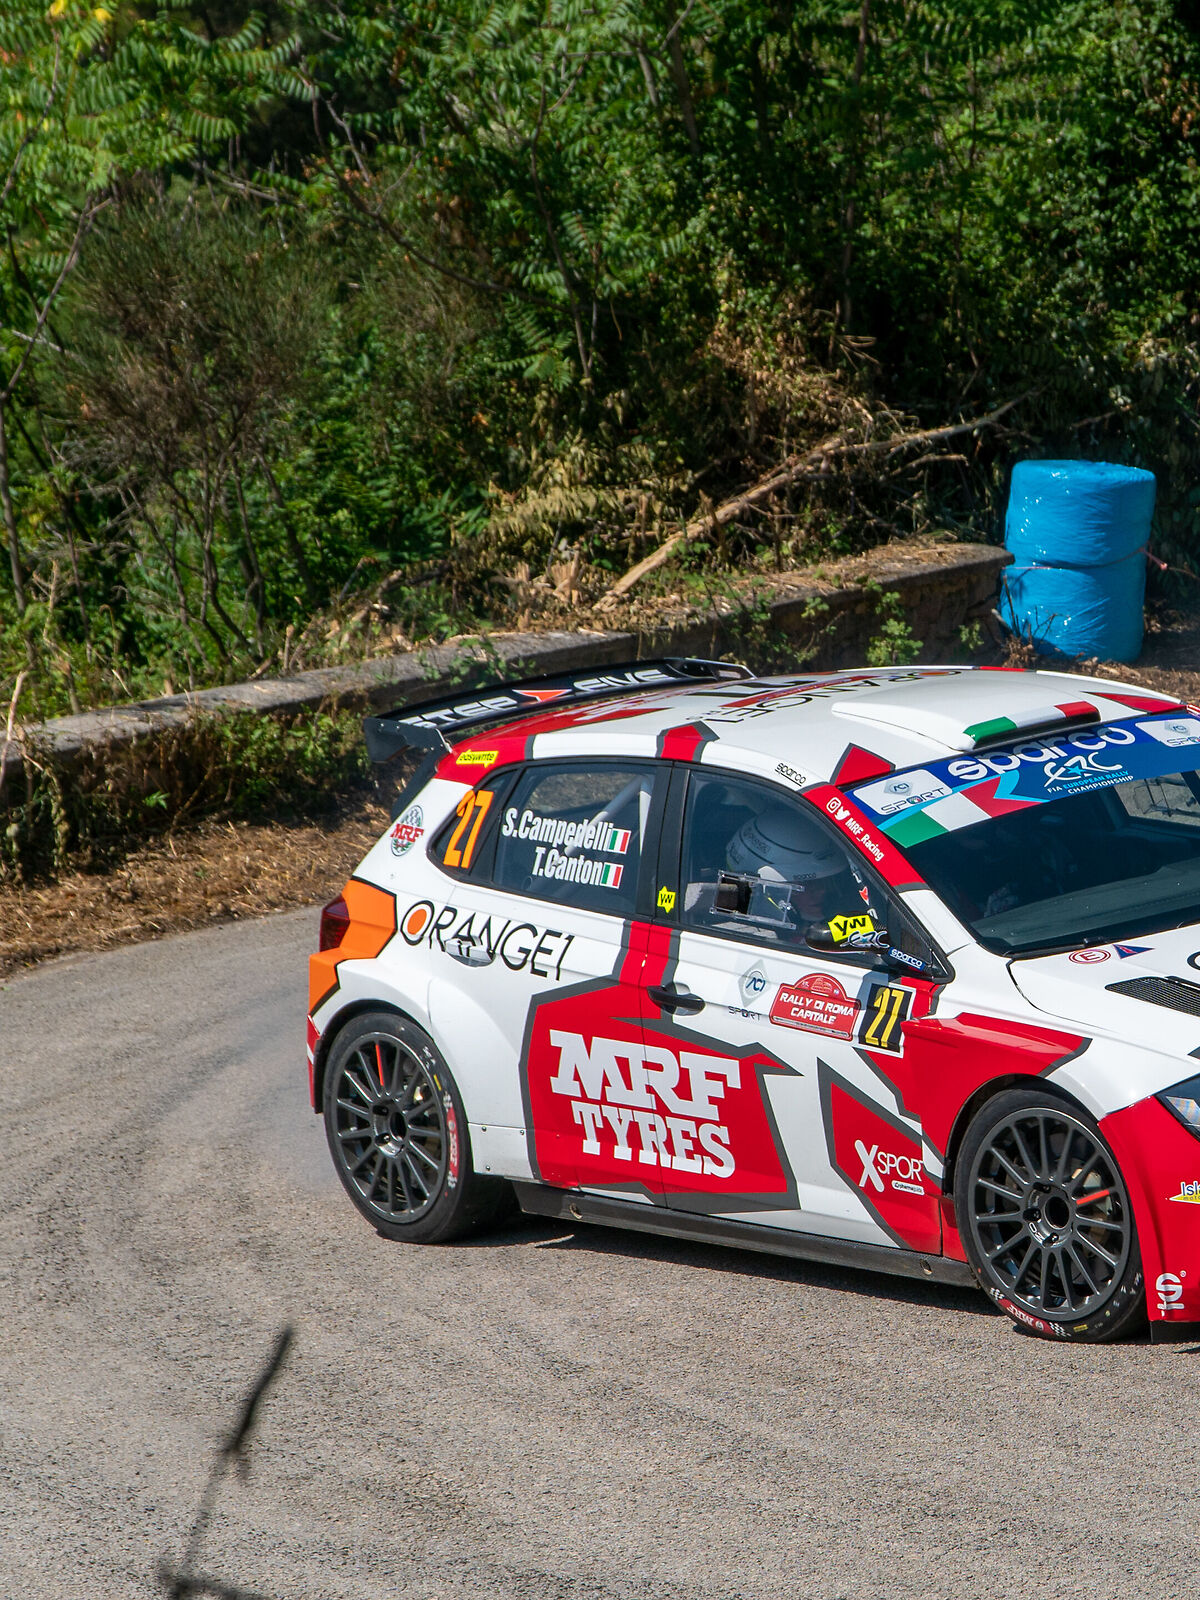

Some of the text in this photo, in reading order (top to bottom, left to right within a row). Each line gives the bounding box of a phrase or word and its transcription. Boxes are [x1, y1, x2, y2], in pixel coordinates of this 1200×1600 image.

[948, 727, 1136, 780] sparco
[1063, 775, 1105, 789] EUROPEAN
[1105, 770, 1129, 782] RALLY
[1067, 775, 1134, 794] CHAMPIONSHIP
[881, 787, 945, 814] SPORT
[390, 823, 424, 843] MRF
[443, 790, 494, 869] 27
[400, 900, 575, 981] ORANGE1
[891, 948, 923, 968] sparco
[728, 1006, 762, 1021] SPORT
[780, 993, 813, 1007] RALLY
[825, 1003, 854, 1016] ROMA
[790, 1007, 837, 1024] CAPITALE
[865, 987, 905, 1047] 27
[549, 1029, 742, 1122] MRF
[571, 1100, 736, 1179] TYRES
